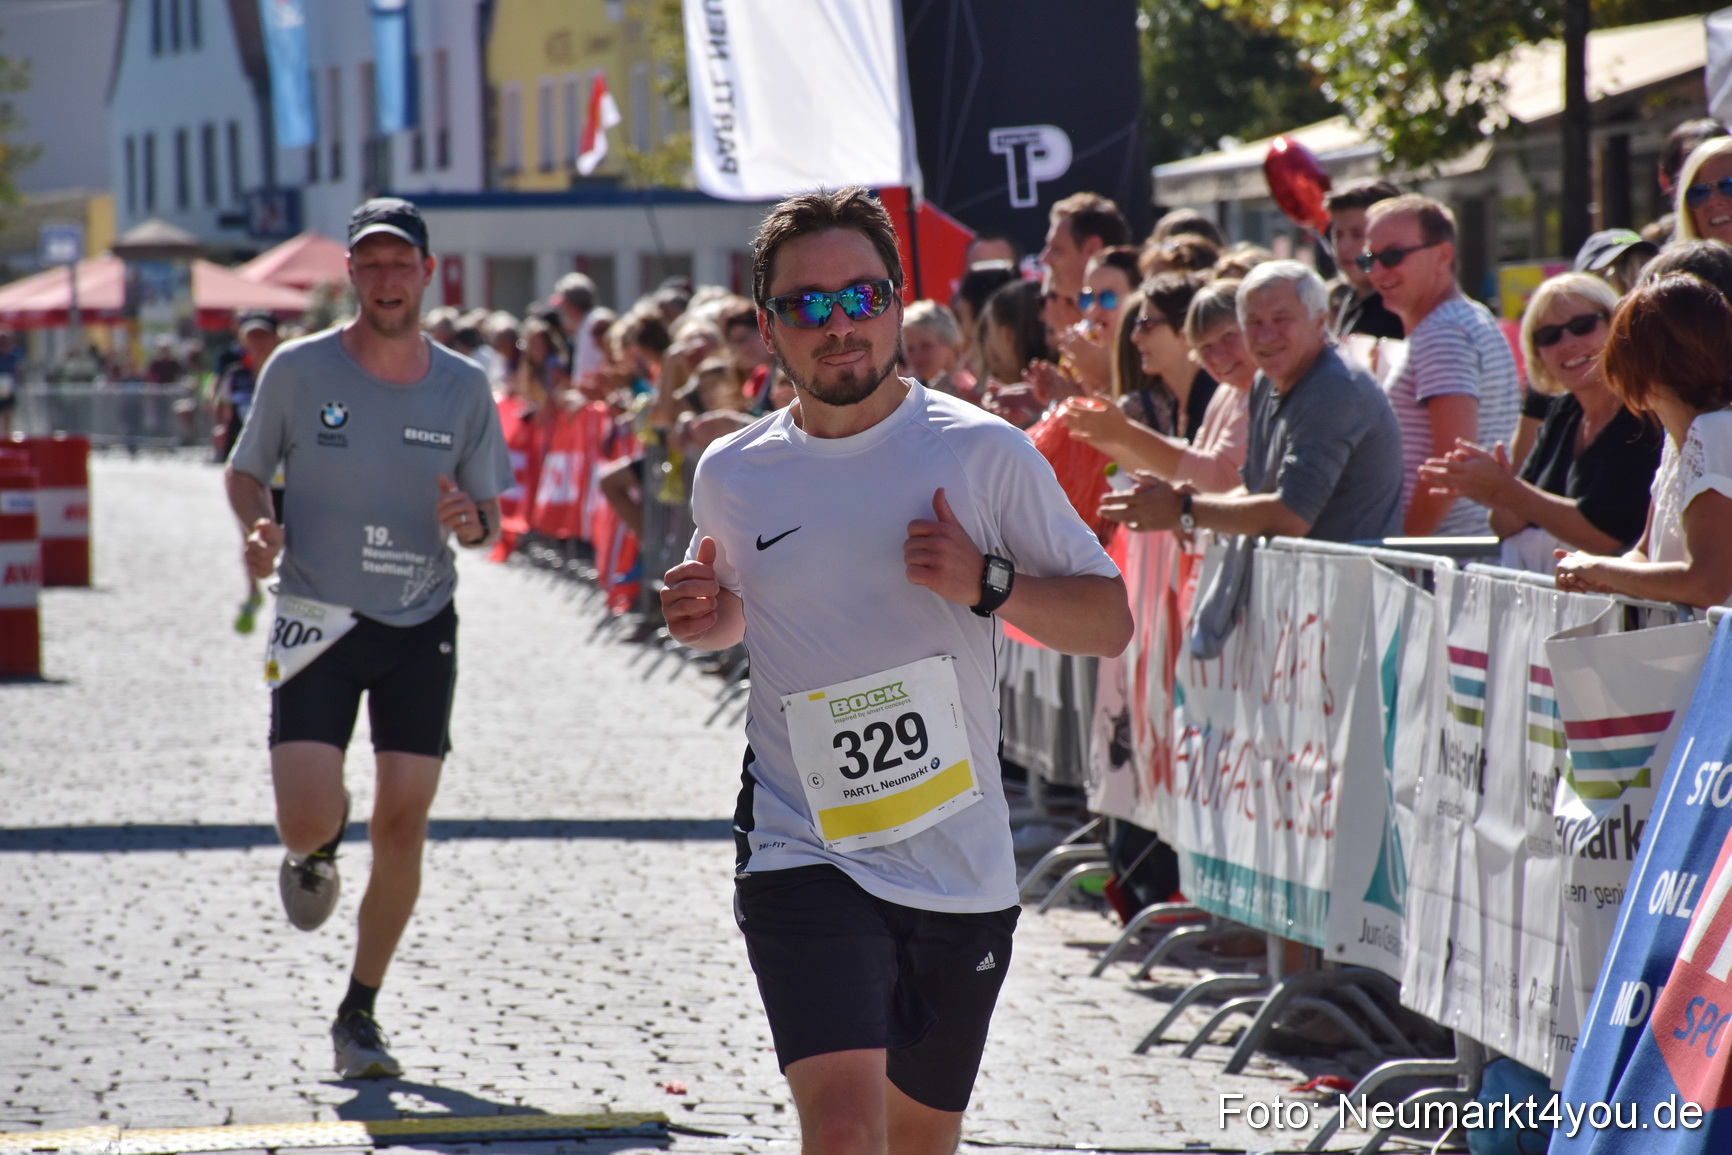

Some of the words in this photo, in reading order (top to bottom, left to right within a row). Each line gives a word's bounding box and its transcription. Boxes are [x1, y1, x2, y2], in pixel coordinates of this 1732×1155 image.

[404, 427, 452, 446] BOCK
[364, 525, 393, 547] 19.
[829, 681, 909, 718] BOCK
[834, 713, 858, 724] inspired
[858, 710, 866, 718] by
[866, 706, 884, 716] smart
[884, 698, 912, 711] concepts
[833, 711, 929, 780] 329
[843, 785, 879, 798] PARTL
[880, 765, 928, 790] Neumarkt
[976, 962, 996, 972] adidas
